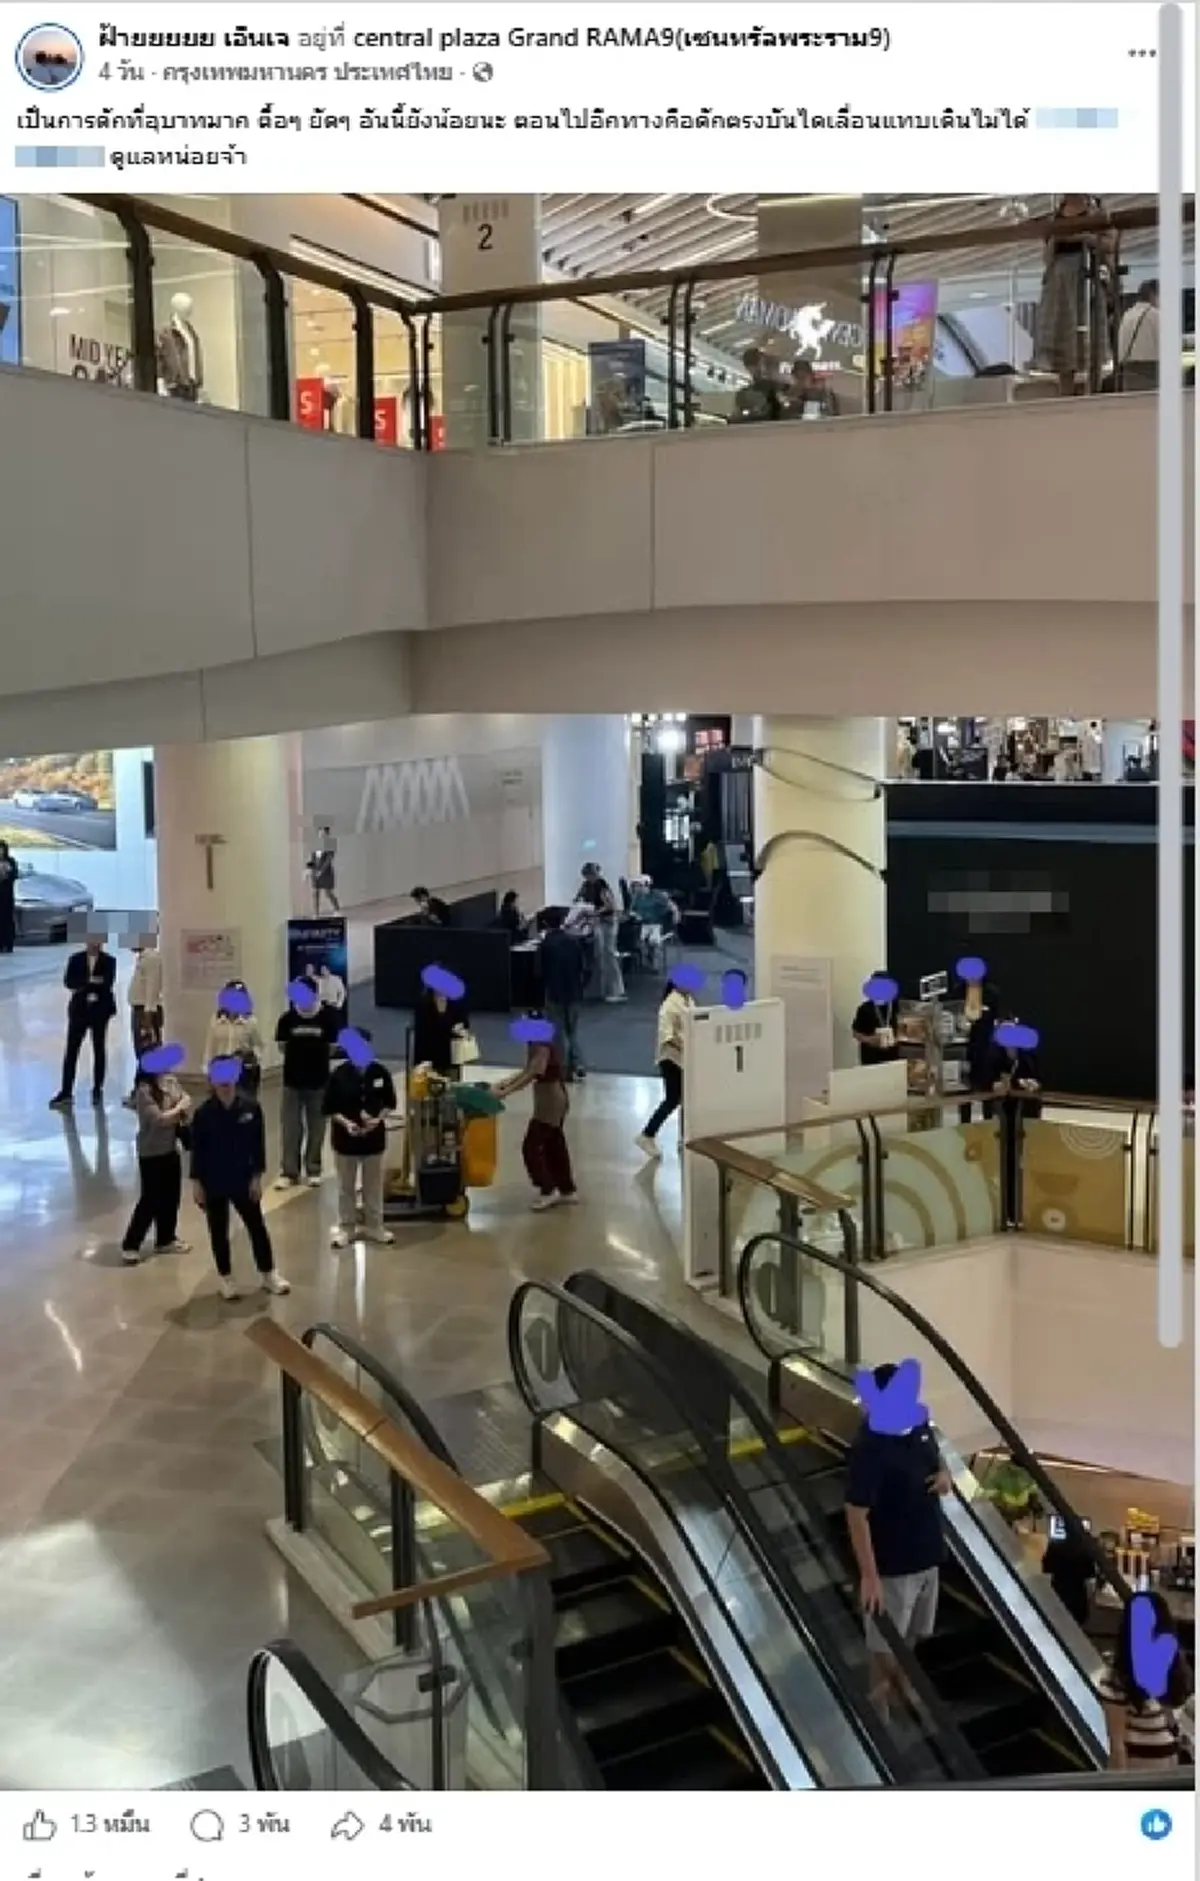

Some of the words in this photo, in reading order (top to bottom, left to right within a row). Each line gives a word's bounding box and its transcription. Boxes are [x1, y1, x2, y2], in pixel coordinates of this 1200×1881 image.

[478, 224, 493, 251] 2
[69, 333, 100, 365] MID
[734, 1045, 744, 1073] 1
